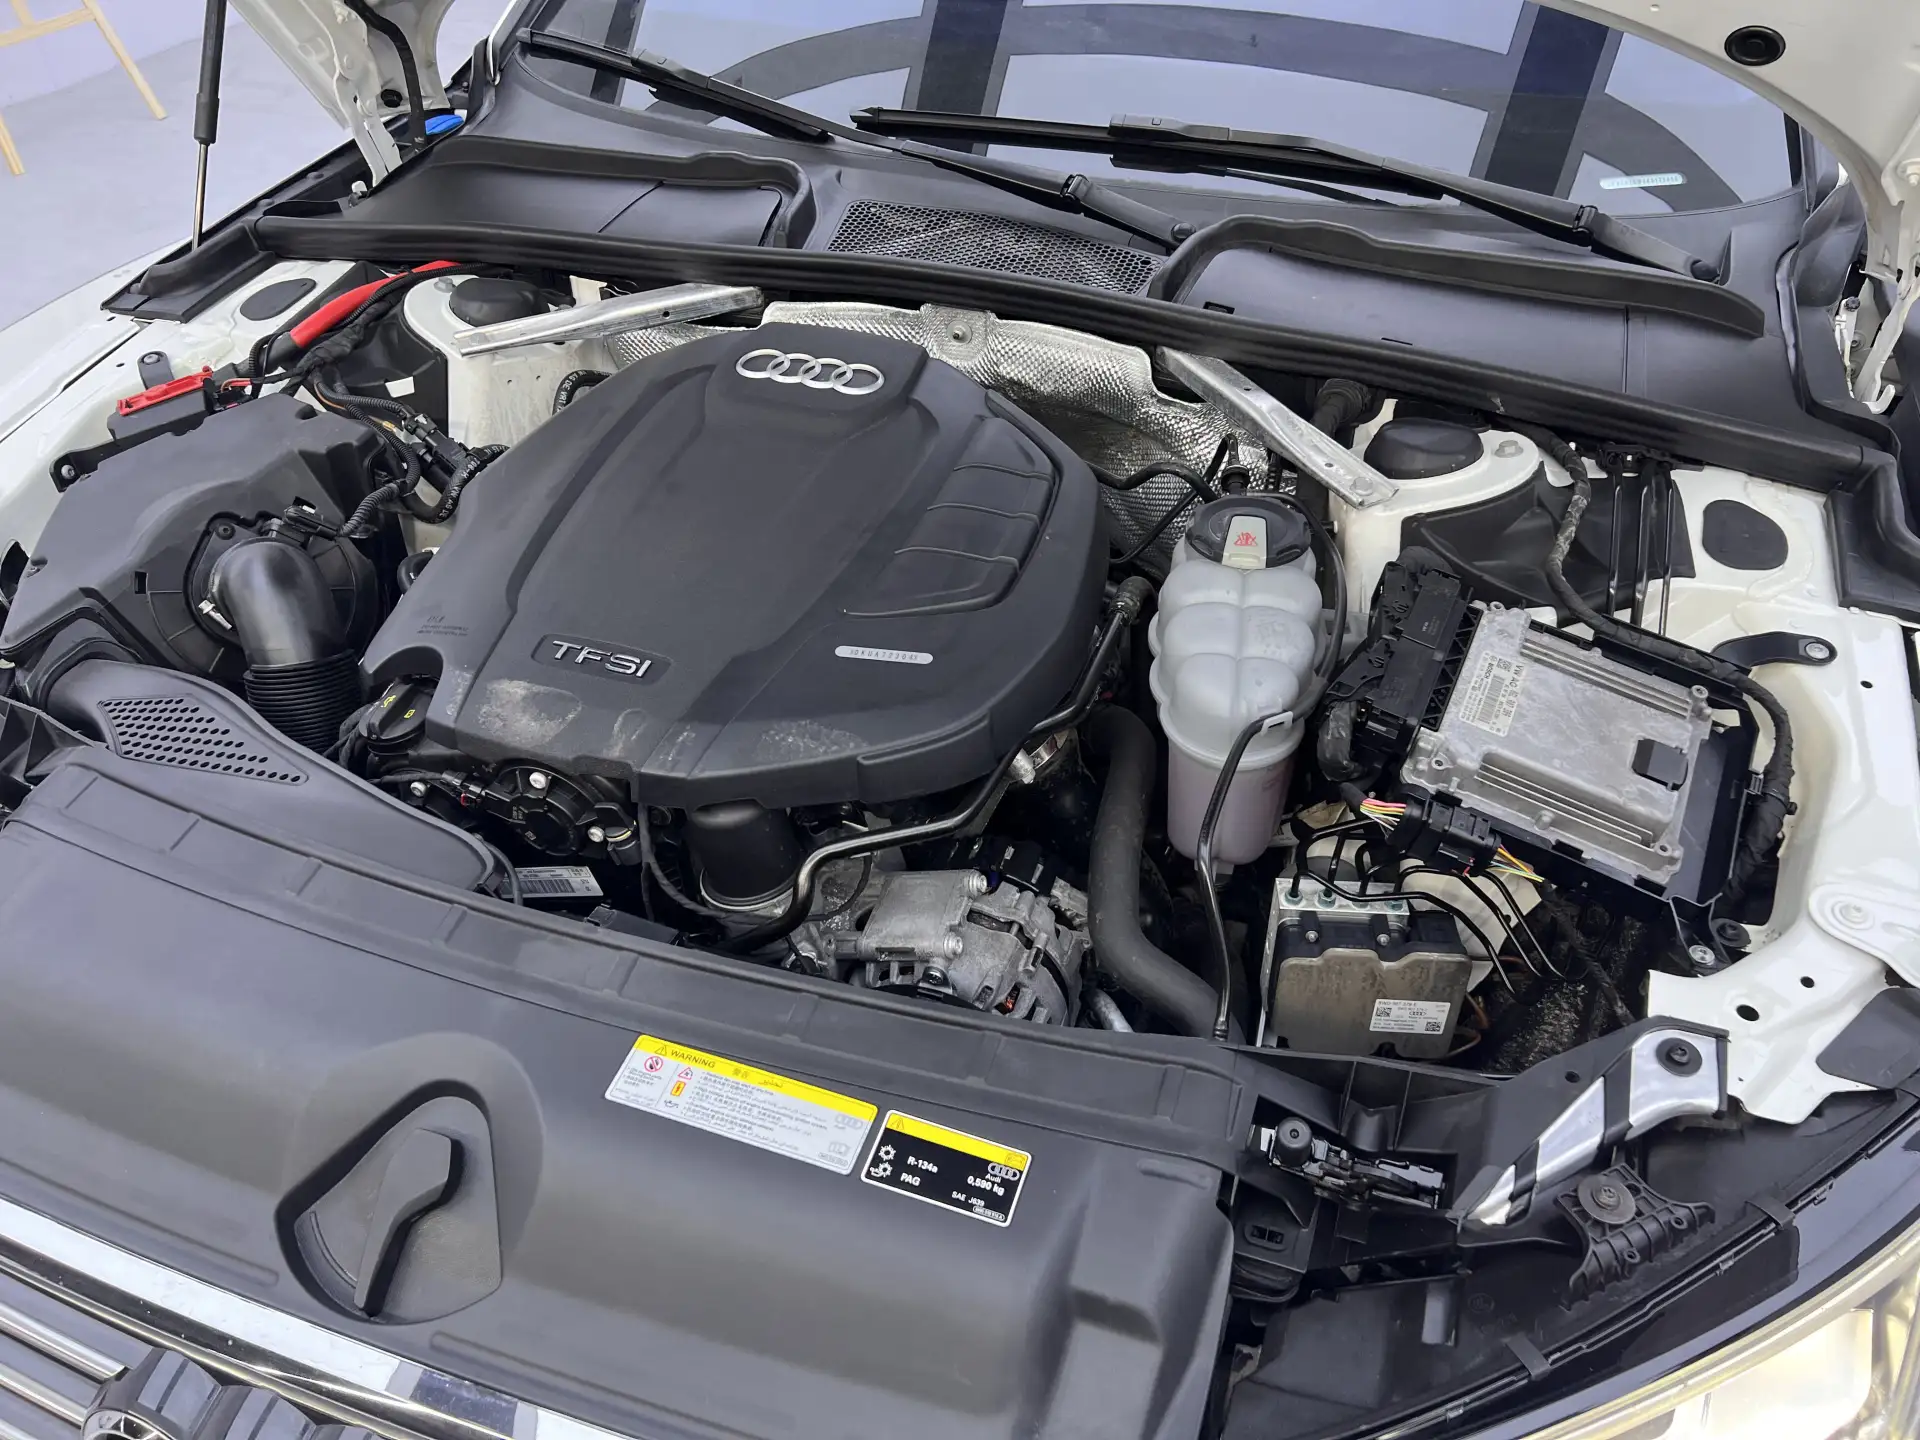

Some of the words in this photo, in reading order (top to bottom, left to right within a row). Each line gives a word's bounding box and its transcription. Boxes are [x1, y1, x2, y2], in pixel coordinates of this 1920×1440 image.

[552, 640, 652, 678] TFSI
[670, 1048, 716, 1069] WARNING
[907, 1156, 939, 1174] R-134a
[900, 1172, 921, 1186] PAG
[985, 1173, 1001, 1183] Audi
[951, 1190, 966, 1202] SAE
[992, 1183, 1005, 1196] kg
